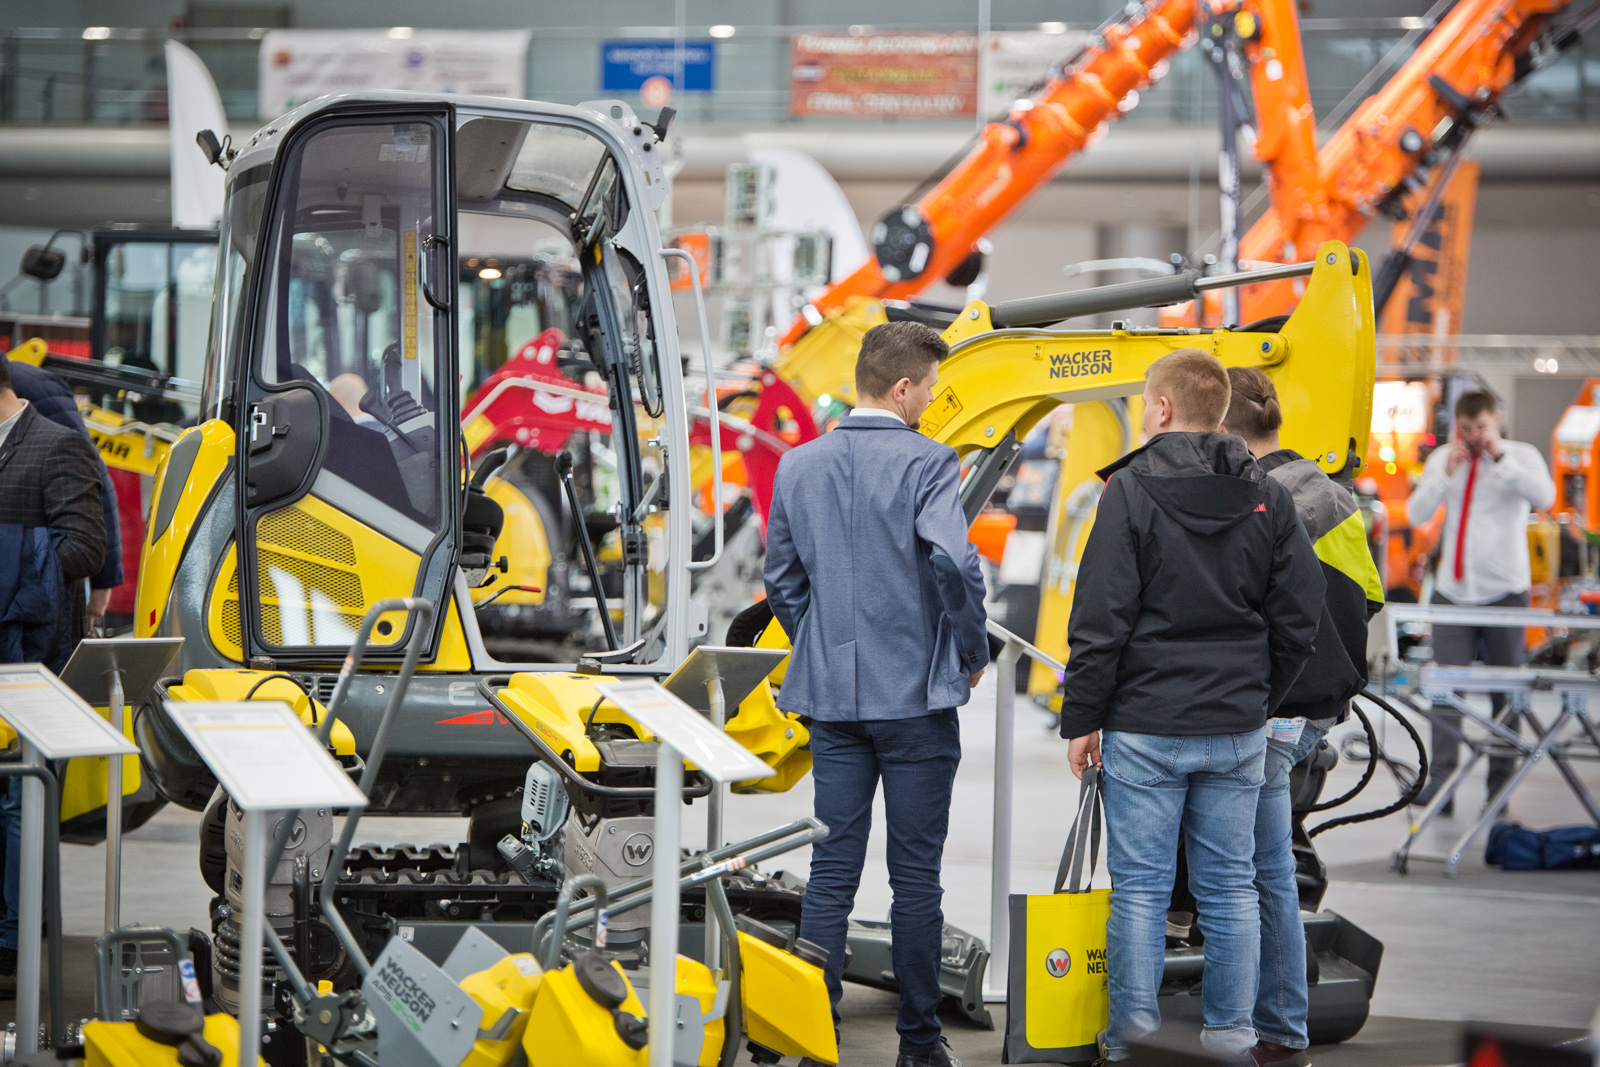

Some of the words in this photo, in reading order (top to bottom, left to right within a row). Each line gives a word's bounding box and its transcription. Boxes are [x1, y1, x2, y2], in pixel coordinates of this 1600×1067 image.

[1049, 349, 1112, 366] WACKER
[1049, 361, 1112, 379] NEUSON
[626, 844, 652, 860] W
[1048, 958, 1069, 972] W
[386, 956, 436, 1013] WACKER
[377, 967, 431, 1023] NEUSON
